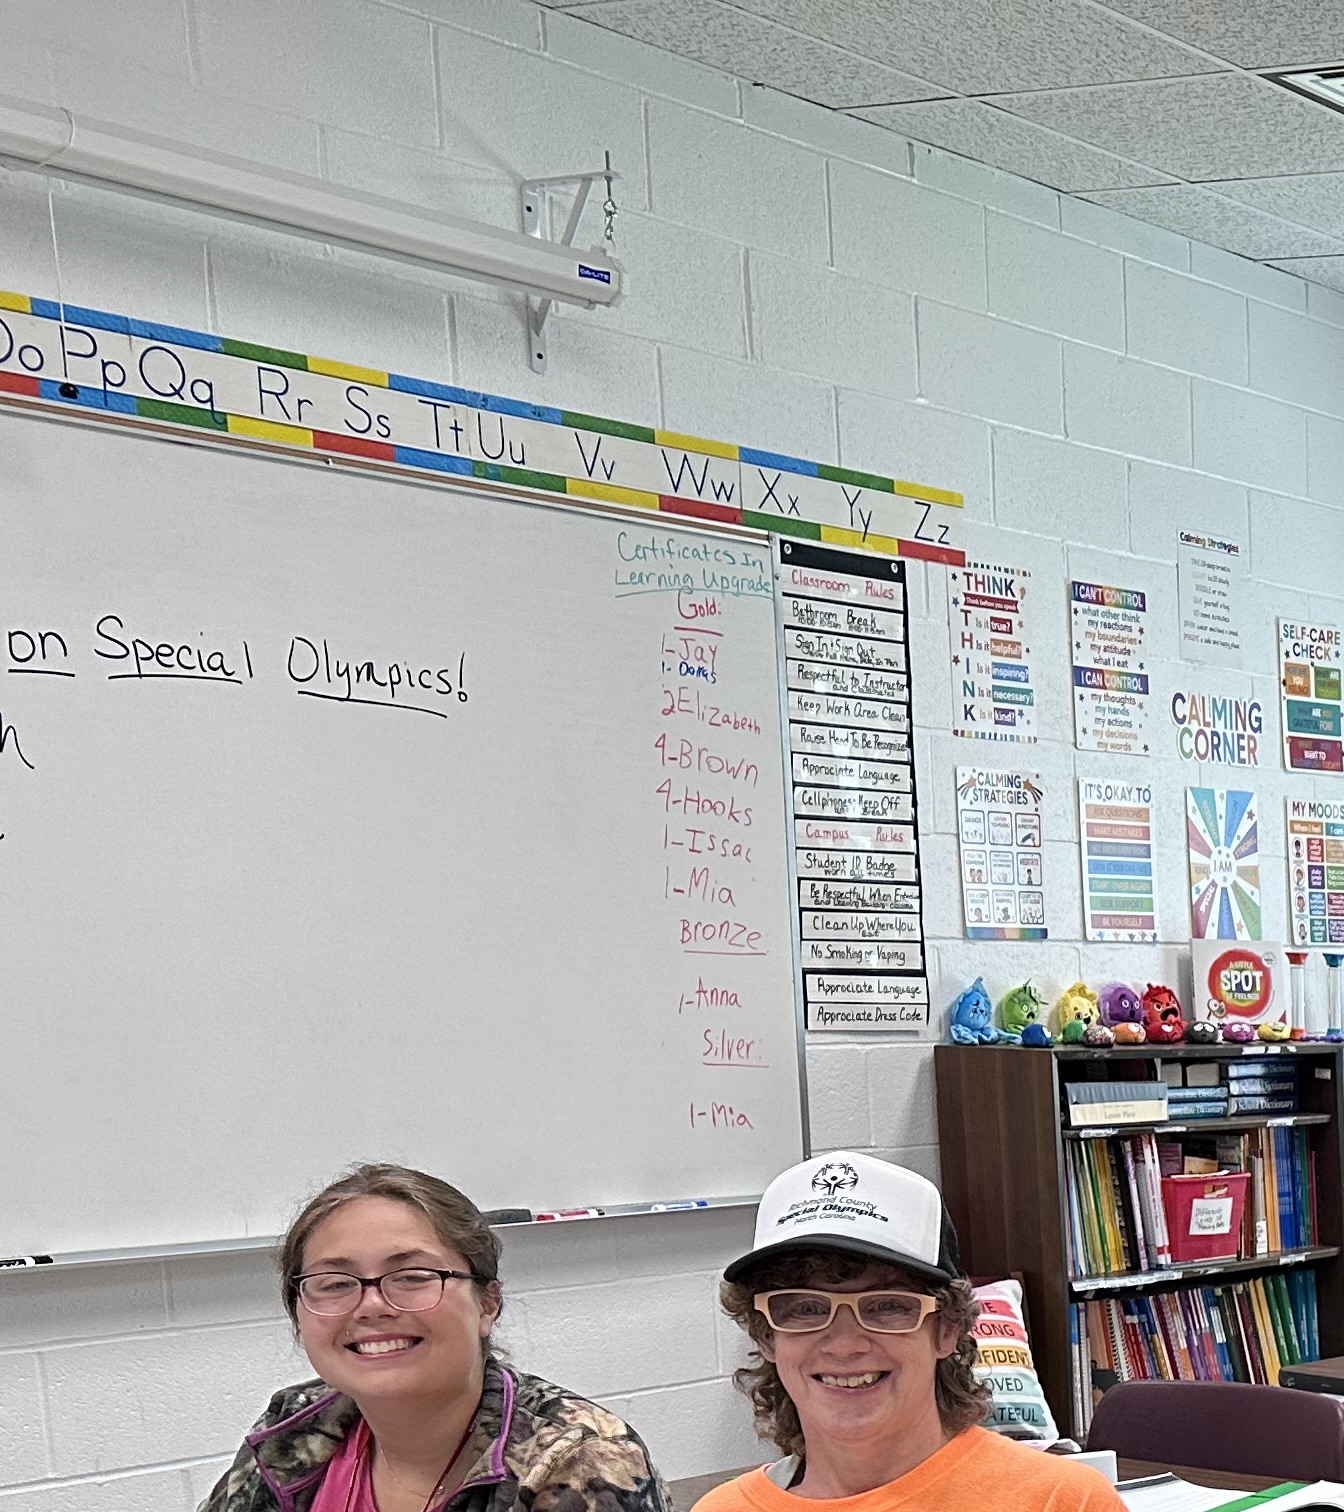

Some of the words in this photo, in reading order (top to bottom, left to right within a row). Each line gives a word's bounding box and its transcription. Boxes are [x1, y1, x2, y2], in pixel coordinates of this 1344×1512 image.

[617, 532, 735, 564] Certificates
[743, 552, 764, 573] In
[615, 564, 694, 594] Learning
[703, 568, 772, 595] Upgrade
[791, 569, 850, 593] Classroom
[865, 581, 895, 600] Rules
[963, 572, 1016, 597] THINK
[1104, 589, 1143, 607] CONTROL
[1283, 624, 1340, 645] SELF-CARE
[8, 629, 68, 663] on
[95, 615, 253, 680] Special
[287, 635, 469, 704] Olympics!
[1293, 643, 1331, 661] CHECK
[797, 664, 845, 684] Respectful
[1086, 671, 1103, 685] CAN
[1104, 674, 1143, 691] CONTROL
[826, 698, 850, 717] Work
[854, 702, 879, 719] Area
[881, 706, 905, 722] Clean
[1172, 693, 1262, 734] CALMING
[1179, 727, 1259, 766] CORNER
[654, 733, 759, 788] 4-Brown
[858, 764, 901, 785] Language
[977, 772, 1021, 789] CALMING
[656, 778, 752, 826] 4-Hooks
[973, 788, 1028, 805] STRATEGIES
[1085, 783, 1102, 800] IT'S
[1105, 785, 1132, 801] OKAY
[1136, 787, 1151, 803] TO
[1292, 801, 1306, 817] MY
[1309, 802, 1344, 819] MOODS
[806, 823, 849, 841] Campus
[876, 826, 904, 843] Rules
[804, 852, 847, 870] Student
[1219, 860, 1232, 873] AM
[664, 866, 736, 907] 1-Mia
[813, 915, 848, 931] Clean
[825, 944, 862, 962] Smoking
[876, 945, 906, 965] Vaping
[877, 979, 921, 999] Language
[1220, 970, 1263, 991] SPOT
[678, 976, 742, 1014] 1-Anna
[1262, 1080, 1295, 1094] Dictionary
[1262, 1097, 1294, 1111] Dictionary
[690, 1102, 754, 1129] 1-Mia
[821, 1203, 889, 1223] Olympics
